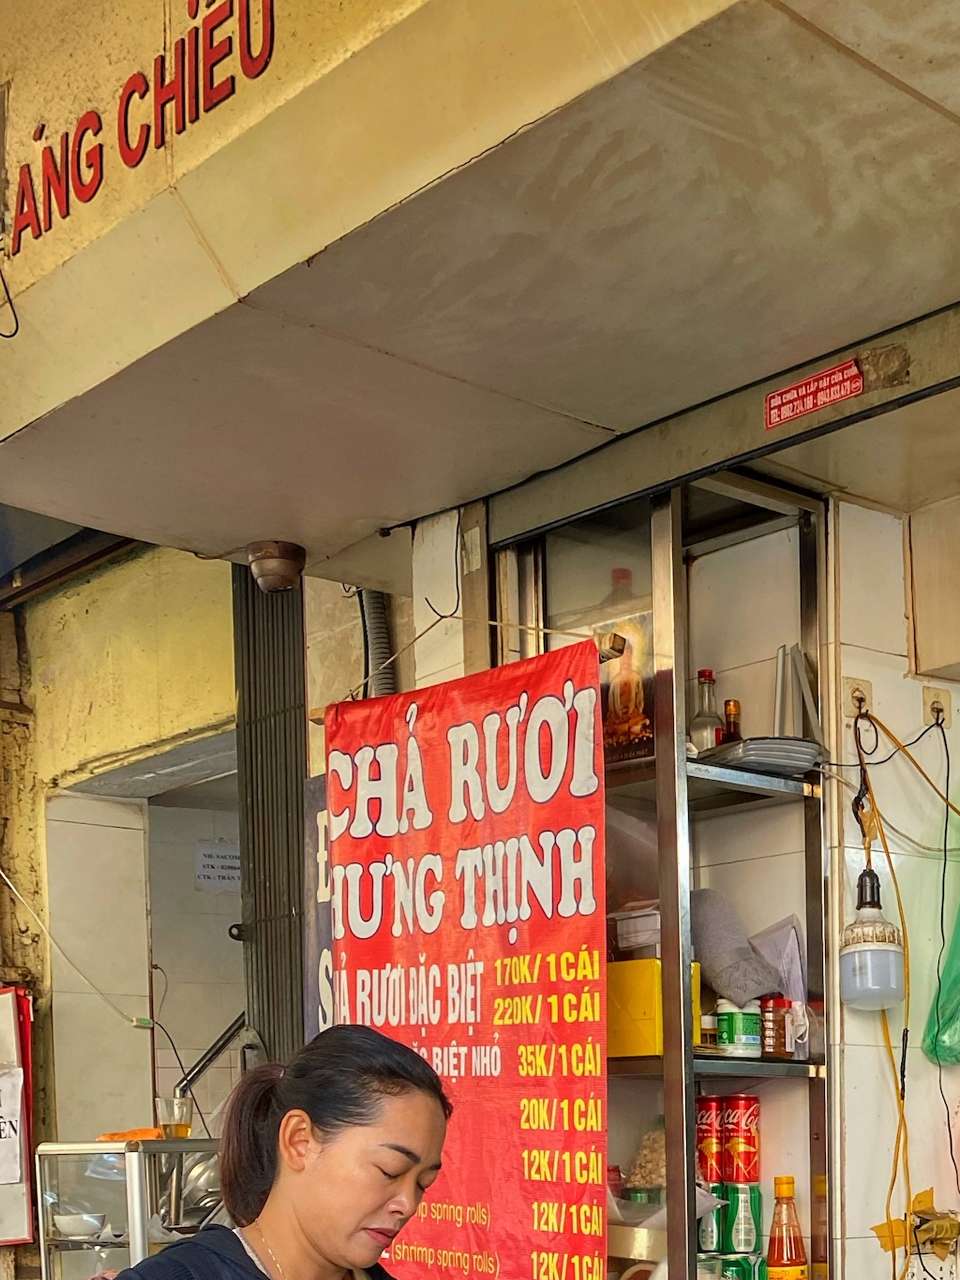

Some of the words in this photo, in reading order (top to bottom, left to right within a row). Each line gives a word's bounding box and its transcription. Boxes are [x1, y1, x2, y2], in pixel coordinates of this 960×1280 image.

[328, 703, 433, 842] CHẢ
[447, 678, 599, 824] RƯƠI
[455, 825, 596, 945] THỊNH
[356, 962, 406, 1028] RƯƠI
[409, 951, 441, 1038] ĐẶC
[447, 948, 485, 1037] BIỆT
[432, 1039, 468, 1083] BIỆT
[471, 1031, 502, 1077] NHỎ
